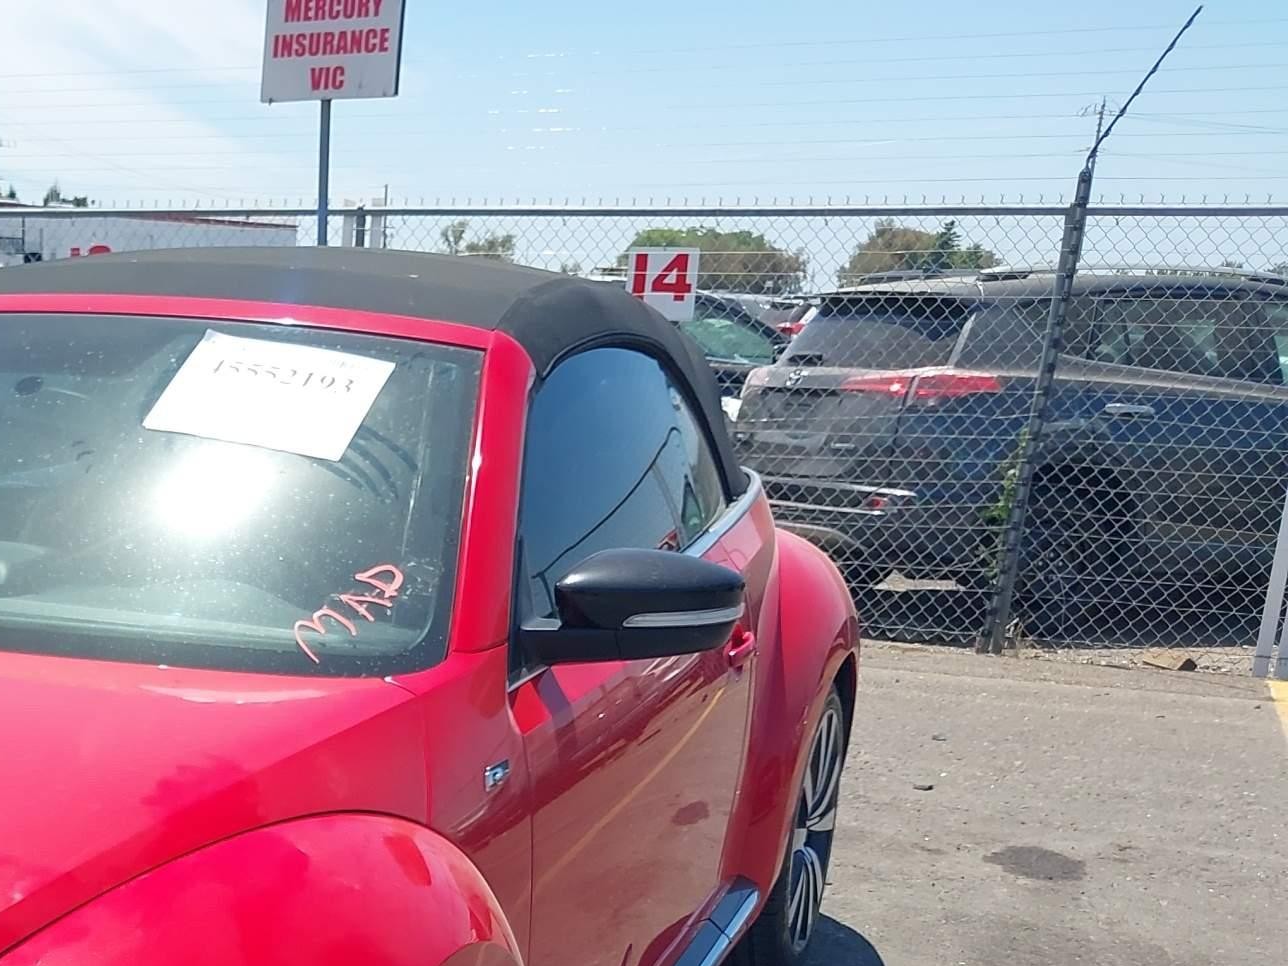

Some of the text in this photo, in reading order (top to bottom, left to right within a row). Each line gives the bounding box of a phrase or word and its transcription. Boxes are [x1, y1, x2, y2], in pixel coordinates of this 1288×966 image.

[284, 0, 383, 23] MERCURY
[272, 28, 390, 58] INSURANCE
[310, 66, 345, 91] VIC
[632, 253, 692, 301] 14
